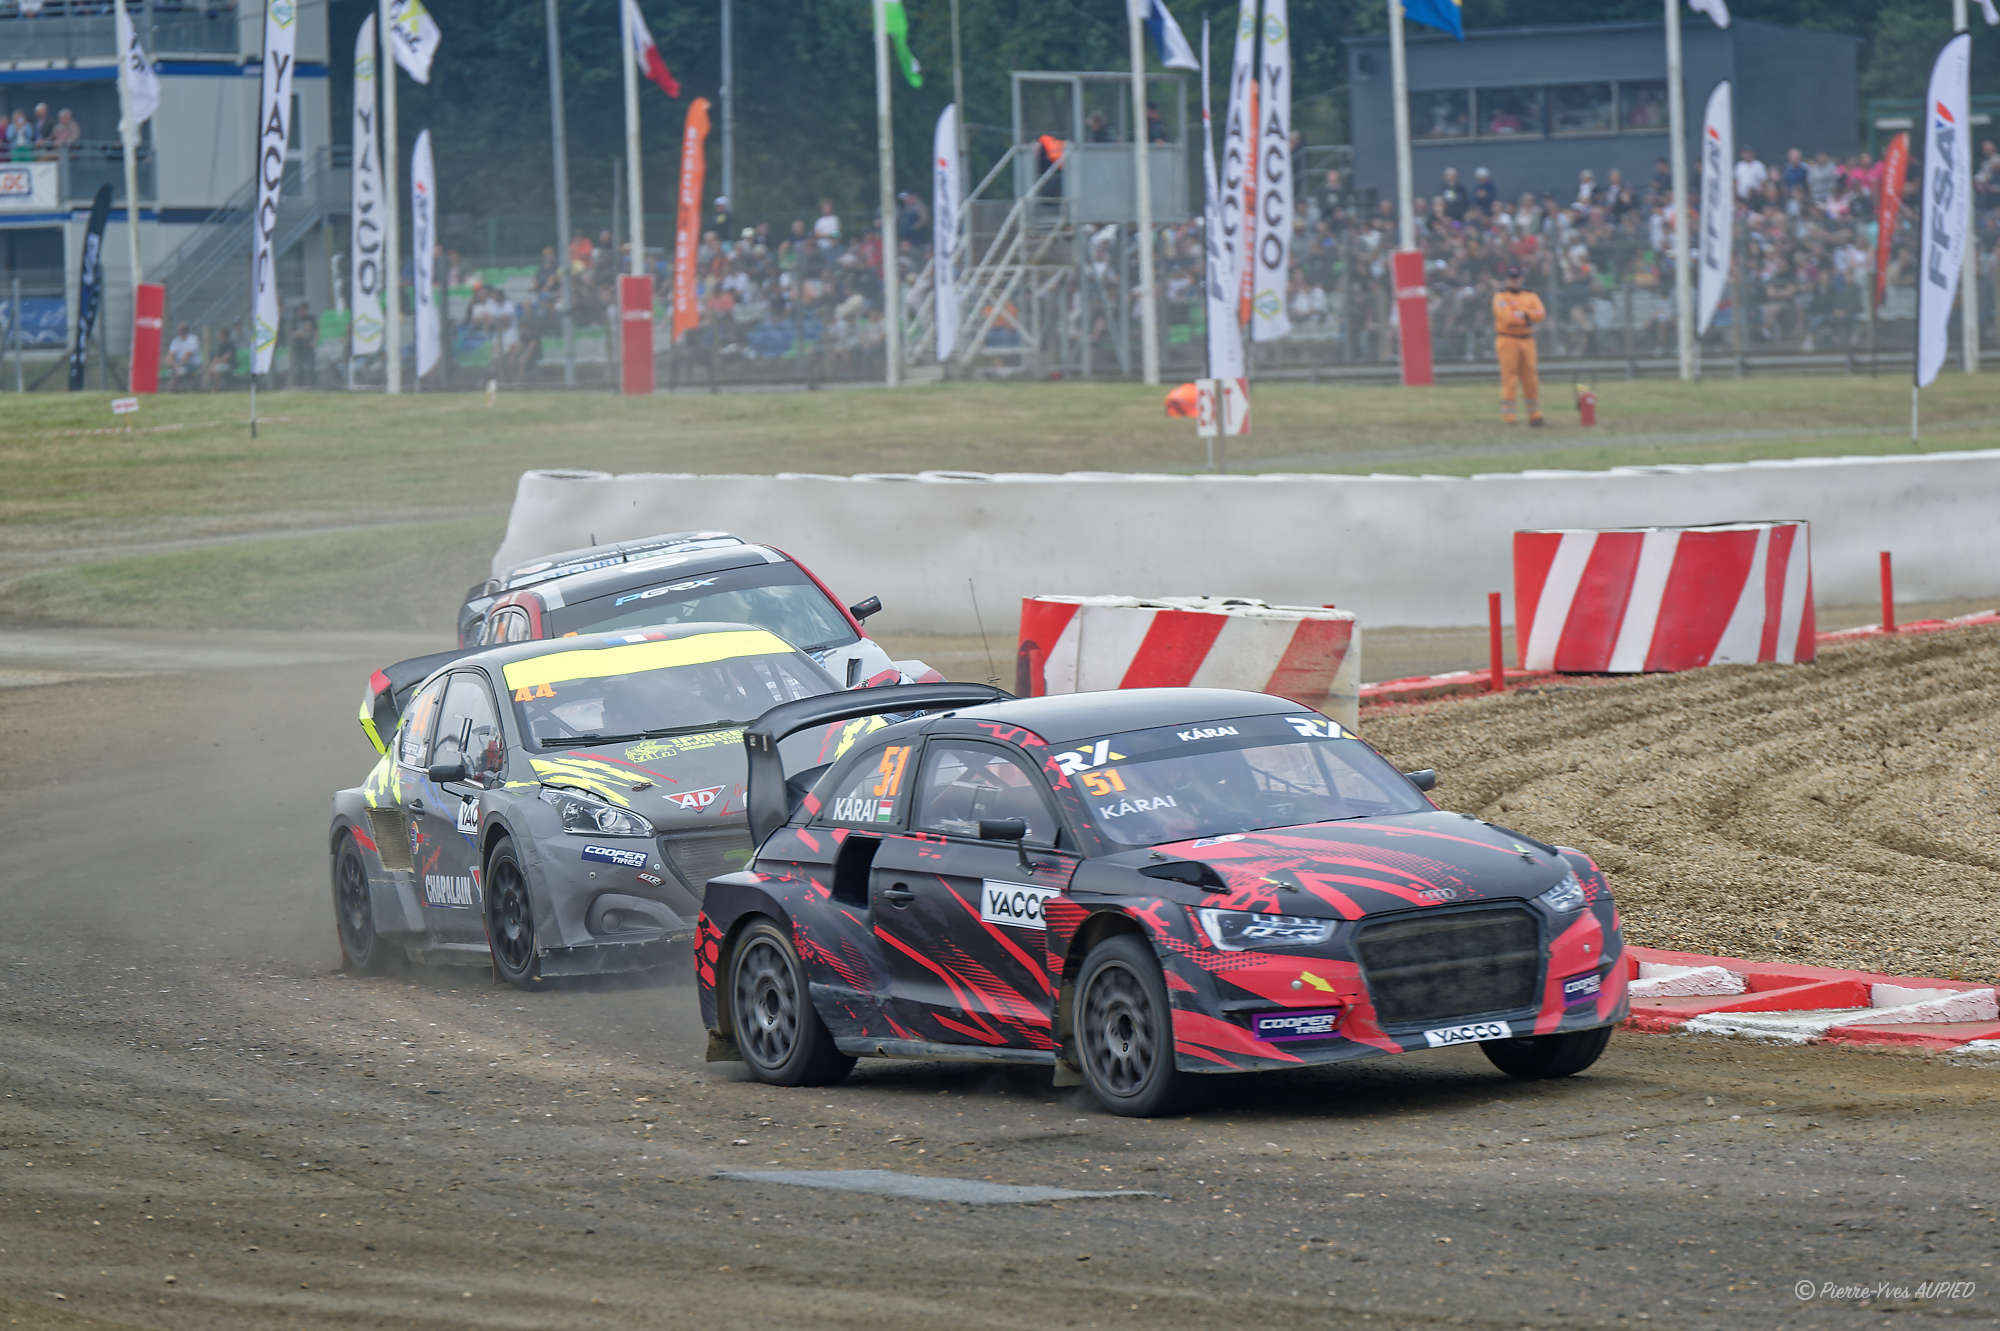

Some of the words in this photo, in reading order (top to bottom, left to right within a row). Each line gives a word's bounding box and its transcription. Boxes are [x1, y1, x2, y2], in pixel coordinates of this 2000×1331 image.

[1260, 63, 1286, 271] YACCO
[1928, 126, 1956, 291] FFSA
[615, 576, 719, 607] PGRX
[514, 683, 557, 702] 44
[1176, 725, 1240, 742] KÁRAI
[1053, 739, 1127, 777] RX
[873, 746, 912, 797] 51
[1081, 769, 1127, 797] 51
[679, 790, 716, 810] AD
[1100, 795, 1177, 820] KÁRAI
[585, 845, 646, 862] COOPER
[612, 856, 643, 867] TIRES
[425, 873, 473, 905] CHAPALAIN
[1564, 974, 1600, 994] COOPER
[1259, 1014, 1335, 1030] COOPER
[1295, 1024, 1333, 1034] TIRES
[1434, 1025, 1500, 1043] YACCO
